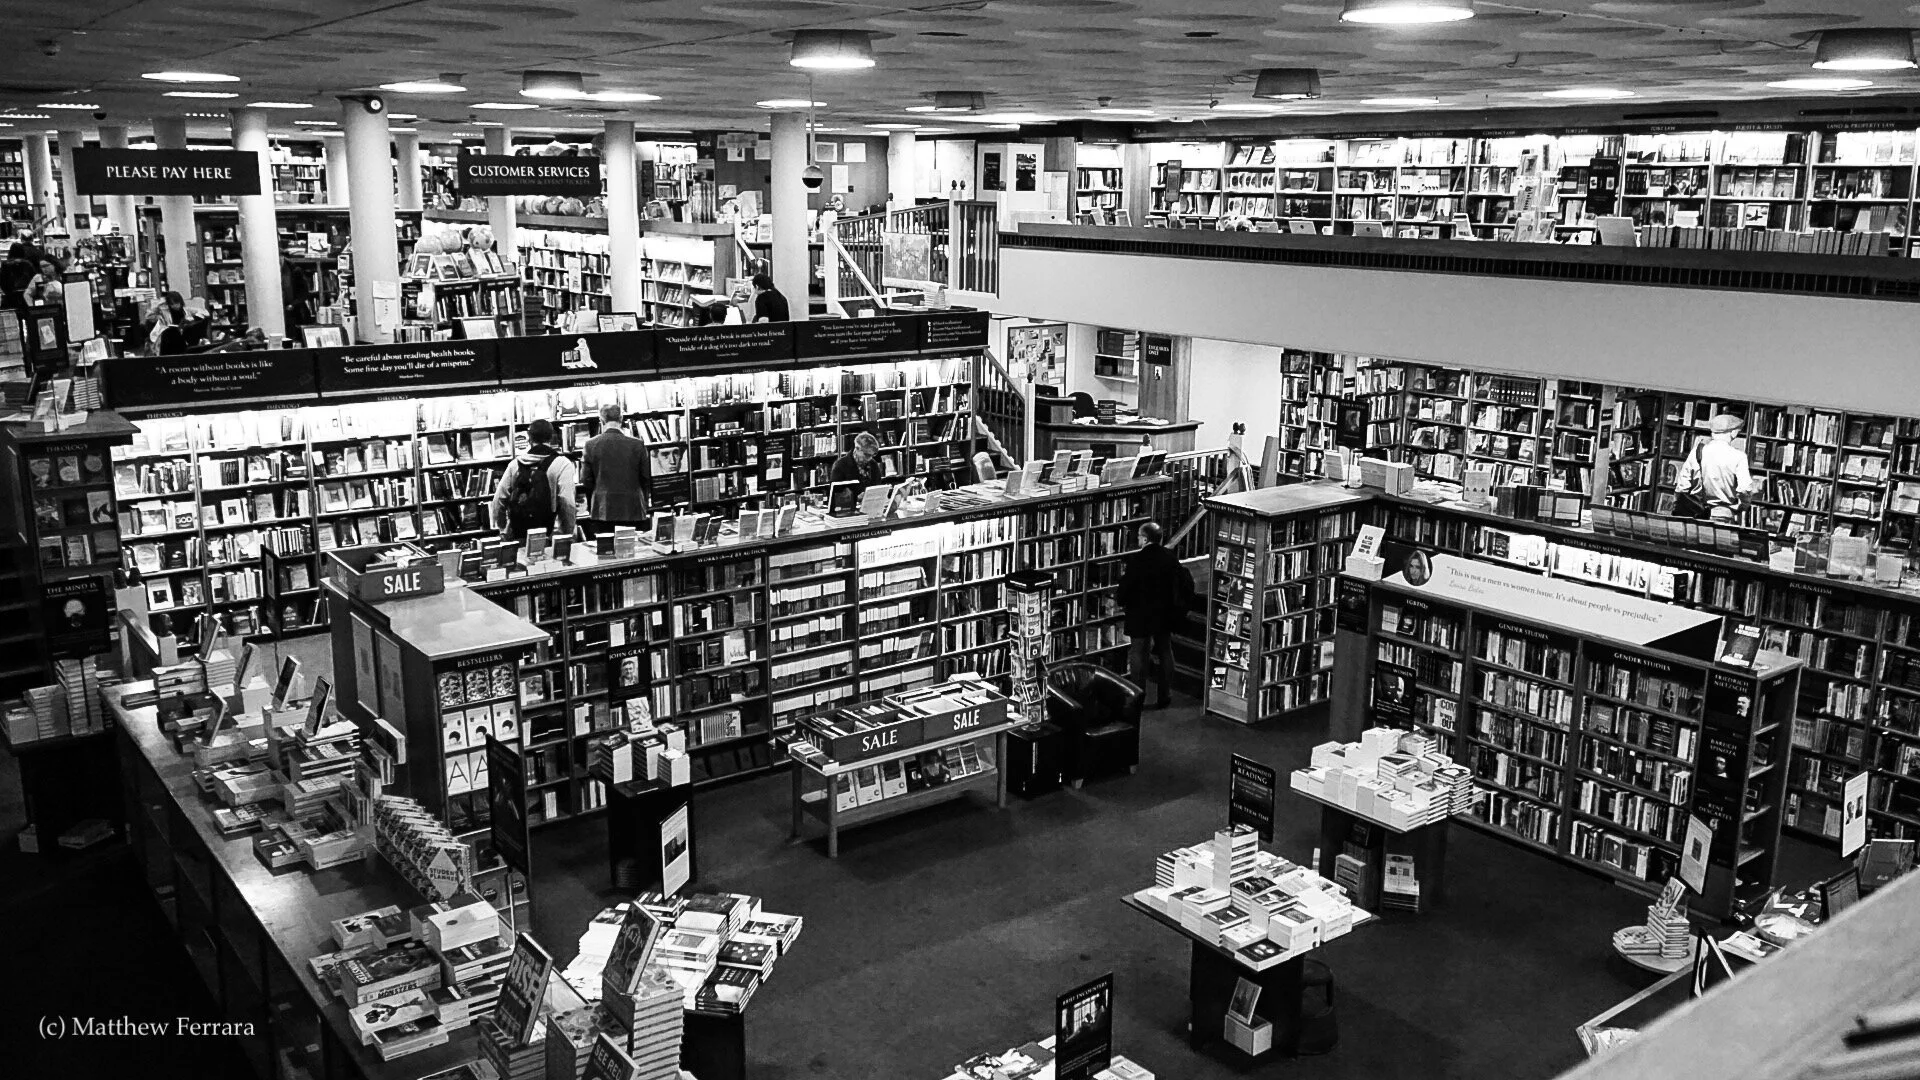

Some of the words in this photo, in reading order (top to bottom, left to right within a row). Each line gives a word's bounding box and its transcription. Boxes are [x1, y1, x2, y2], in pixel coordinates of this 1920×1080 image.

[106, 166, 158, 178] PLEASE
[162, 166, 188, 179] PAY
[193, 167, 232, 180] HERE
[469, 165, 536, 177] CUSTOMER
[538, 166, 590, 178] SERVICES
[340, 354, 354, 363] “Be
[355, 353, 381, 362] careful
[382, 352, 402, 361] about
[403, 351, 430, 361] reading
[430, 350, 452, 359] health
[453, 349, 476, 357] books.
[156, 366, 167, 374] “A
[168, 366, 191, 374] room
[192, 363, 224, 372] without
[225, 362, 250, 370] books
[251, 361, 258, 369] is
[259, 360, 273, 368] like
[344, 366, 364, 375] Some
[365, 365, 379, 373] fine
[380, 364, 393, 373] day
[394, 362, 414, 372] you’ll
[414, 361, 426, 370] die
[426, 361, 434, 369] of
[440, 358, 475, 369] misprint.”
[177, 376, 198, 385] body
[200, 374, 231, 382] without
[238, 371, 261, 380] soul.”
[46, 444, 88, 453] THEOLOGY
[1563, 538, 1587, 548] CULTURE
[1602, 546, 1621, 554] MEDIA
[1664, 557, 1692, 568] CULTURE
[1708, 566, 1730, 574] MEDIA
[383, 572, 421, 594] SALE
[592, 572, 615, 580] WORKS
[47, 586, 62, 594] THE
[64, 583, 88, 592] MIND
[1789, 582, 1832, 596] JOURNALISM
[1487, 578, 1502, 587] men
[1510, 583, 1535, 594] women
[1568, 596, 1588, 607] about
[1588, 600, 1612, 614] people
[1622, 608, 1663, 624] prejudice.”
[1498, 622, 1523, 634] GENDER
[1524, 628, 1549, 640] STUDIES
[457, 654, 503, 668] BESTSELLERS
[608, 651, 627, 661] JOHN
[628, 647, 646, 656] GRAY
[1614, 652, 1642, 665] GENDER
[1644, 659, 1671, 672] STUDIES
[1392, 668, 1413, 678] WOMEN
[1714, 674, 1749, 687] FRIEDRICH
[1714, 680, 1748, 693] NIETZSCHE
[953, 709, 981, 730] SALE
[862, 729, 898, 752] SALE
[1710, 738, 1737, 750] BARUCH
[1234, 759, 1272, 778] RECOMMENDED
[1238, 767, 1268, 785] READING
[378, 983, 418, 999] MONSTERS
[593, 1044, 607, 1066] SEE
